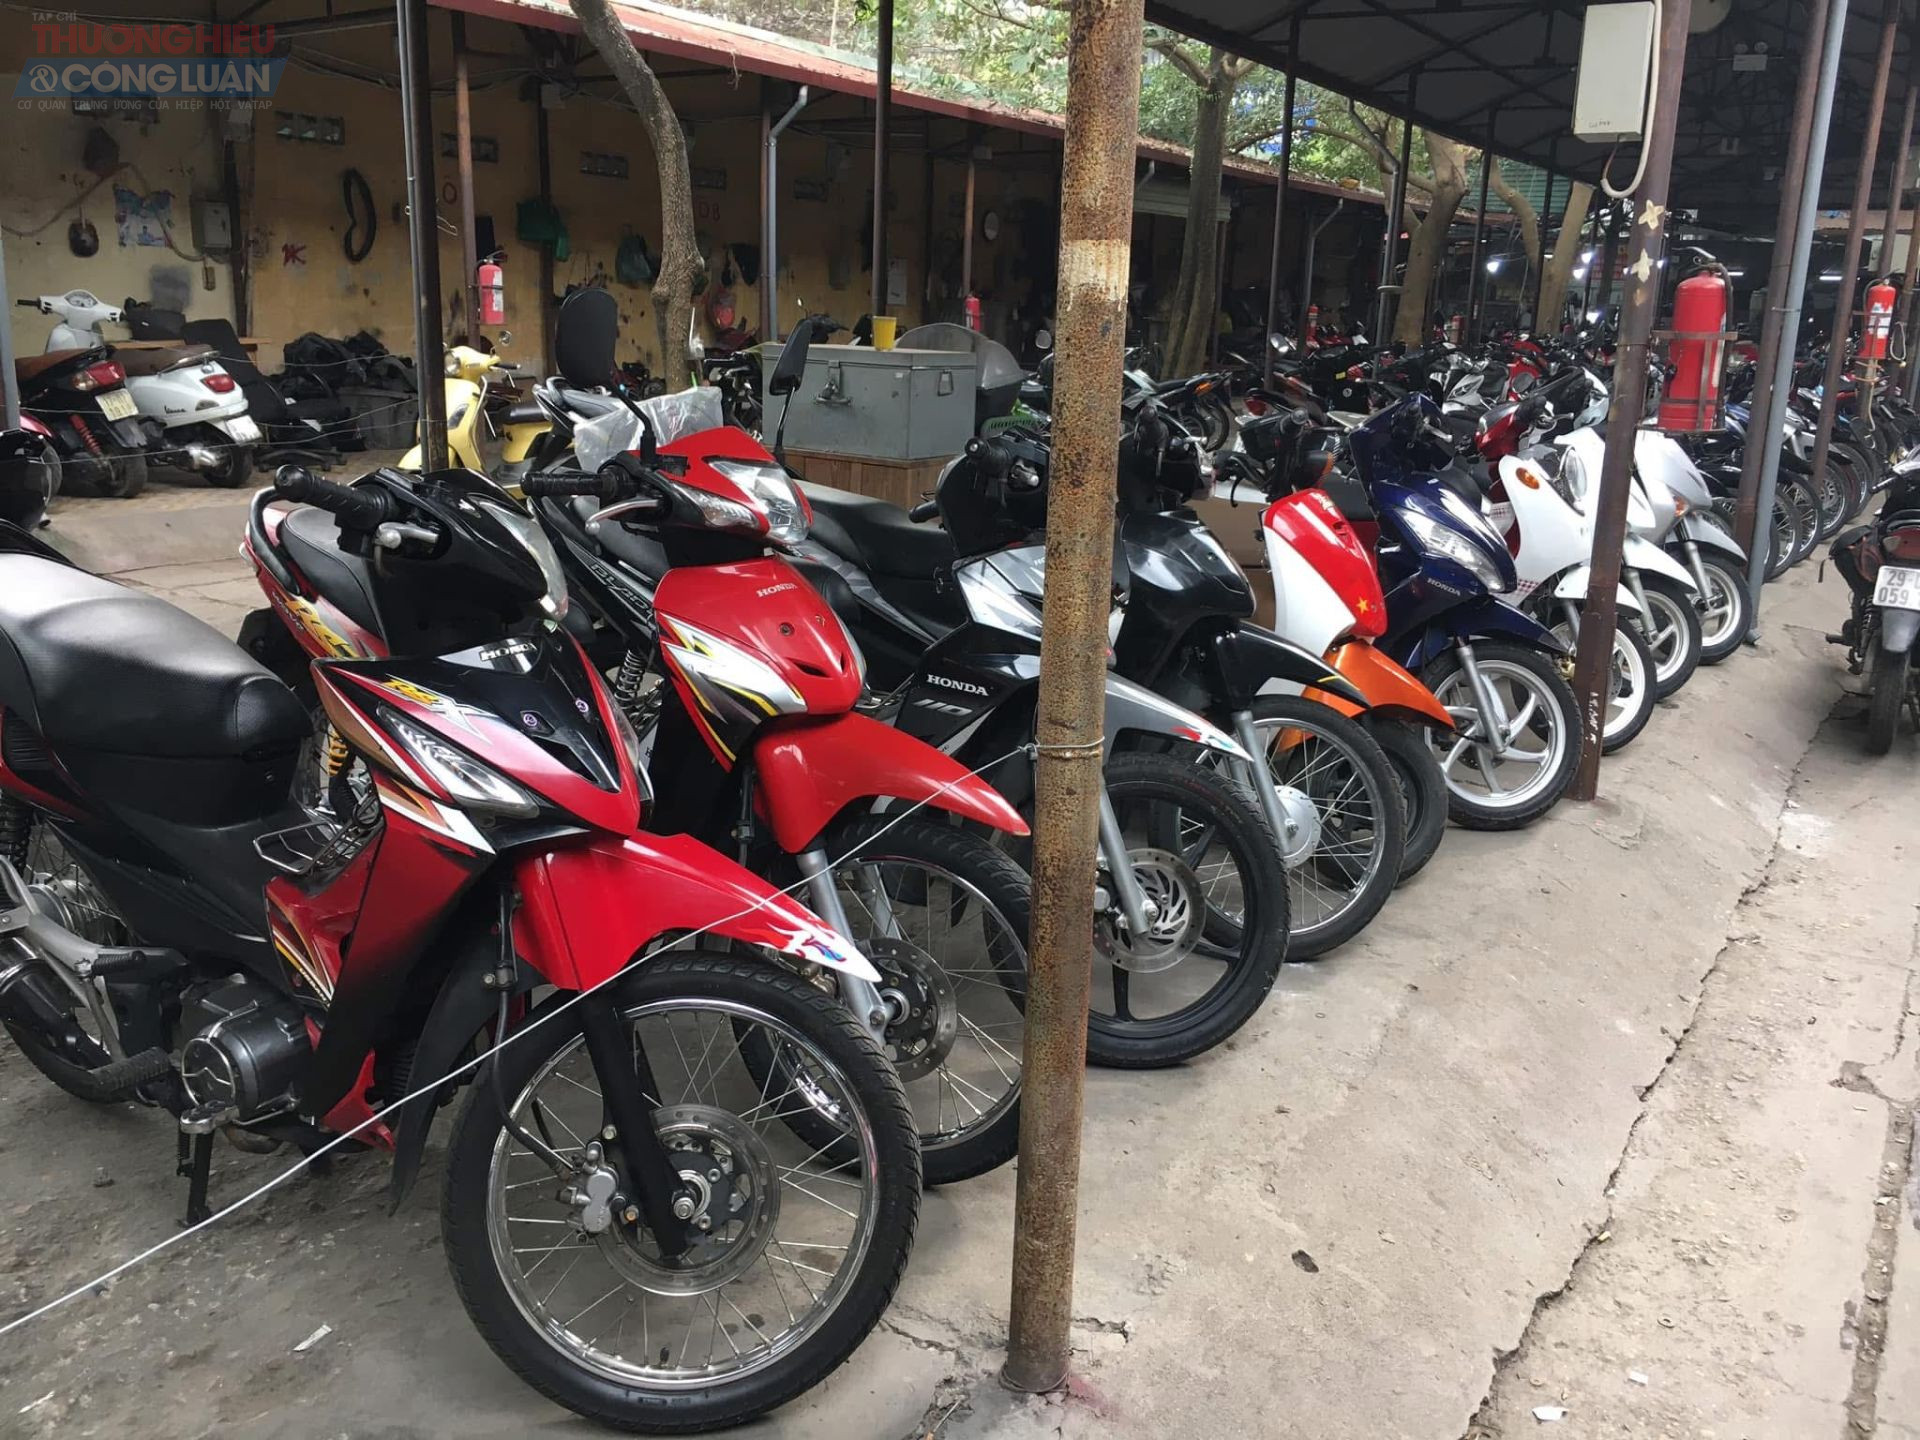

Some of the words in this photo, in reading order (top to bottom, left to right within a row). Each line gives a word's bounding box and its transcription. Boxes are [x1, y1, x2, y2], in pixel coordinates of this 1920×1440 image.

[756, 582, 798, 598] HONDA
[1427, 577, 1460, 597] HONDA
[478, 642, 537, 662] HONDA
[927, 674, 989, 697] HONDA
